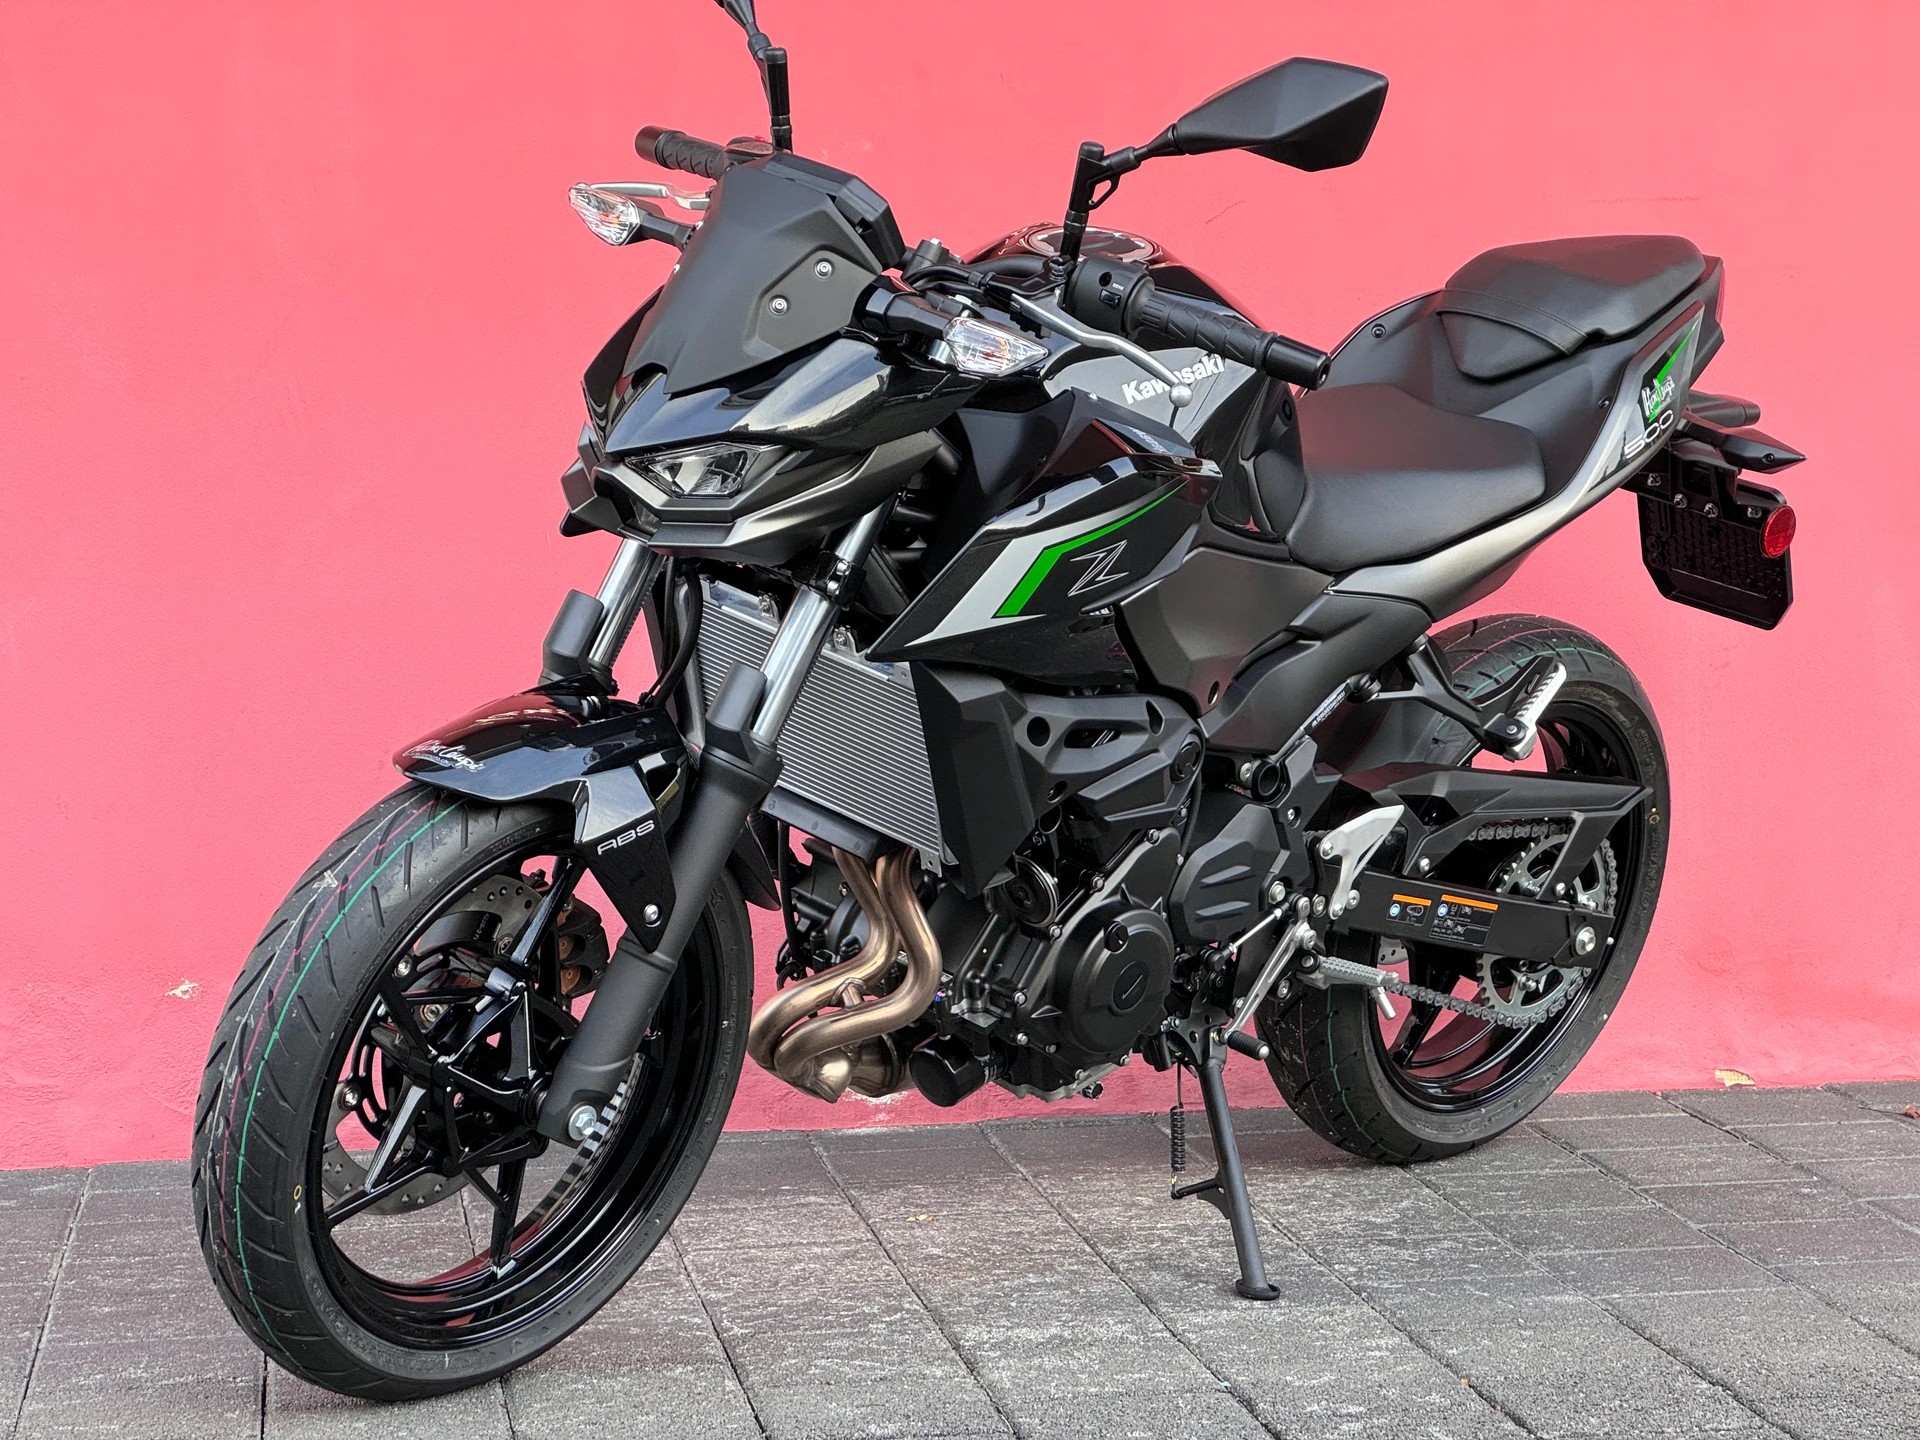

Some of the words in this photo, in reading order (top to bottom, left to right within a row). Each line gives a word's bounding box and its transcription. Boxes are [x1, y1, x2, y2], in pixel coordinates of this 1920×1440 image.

[1623, 409, 1674, 459] 500
[1066, 539, 1130, 597] Z
[597, 819, 655, 856] ABS
